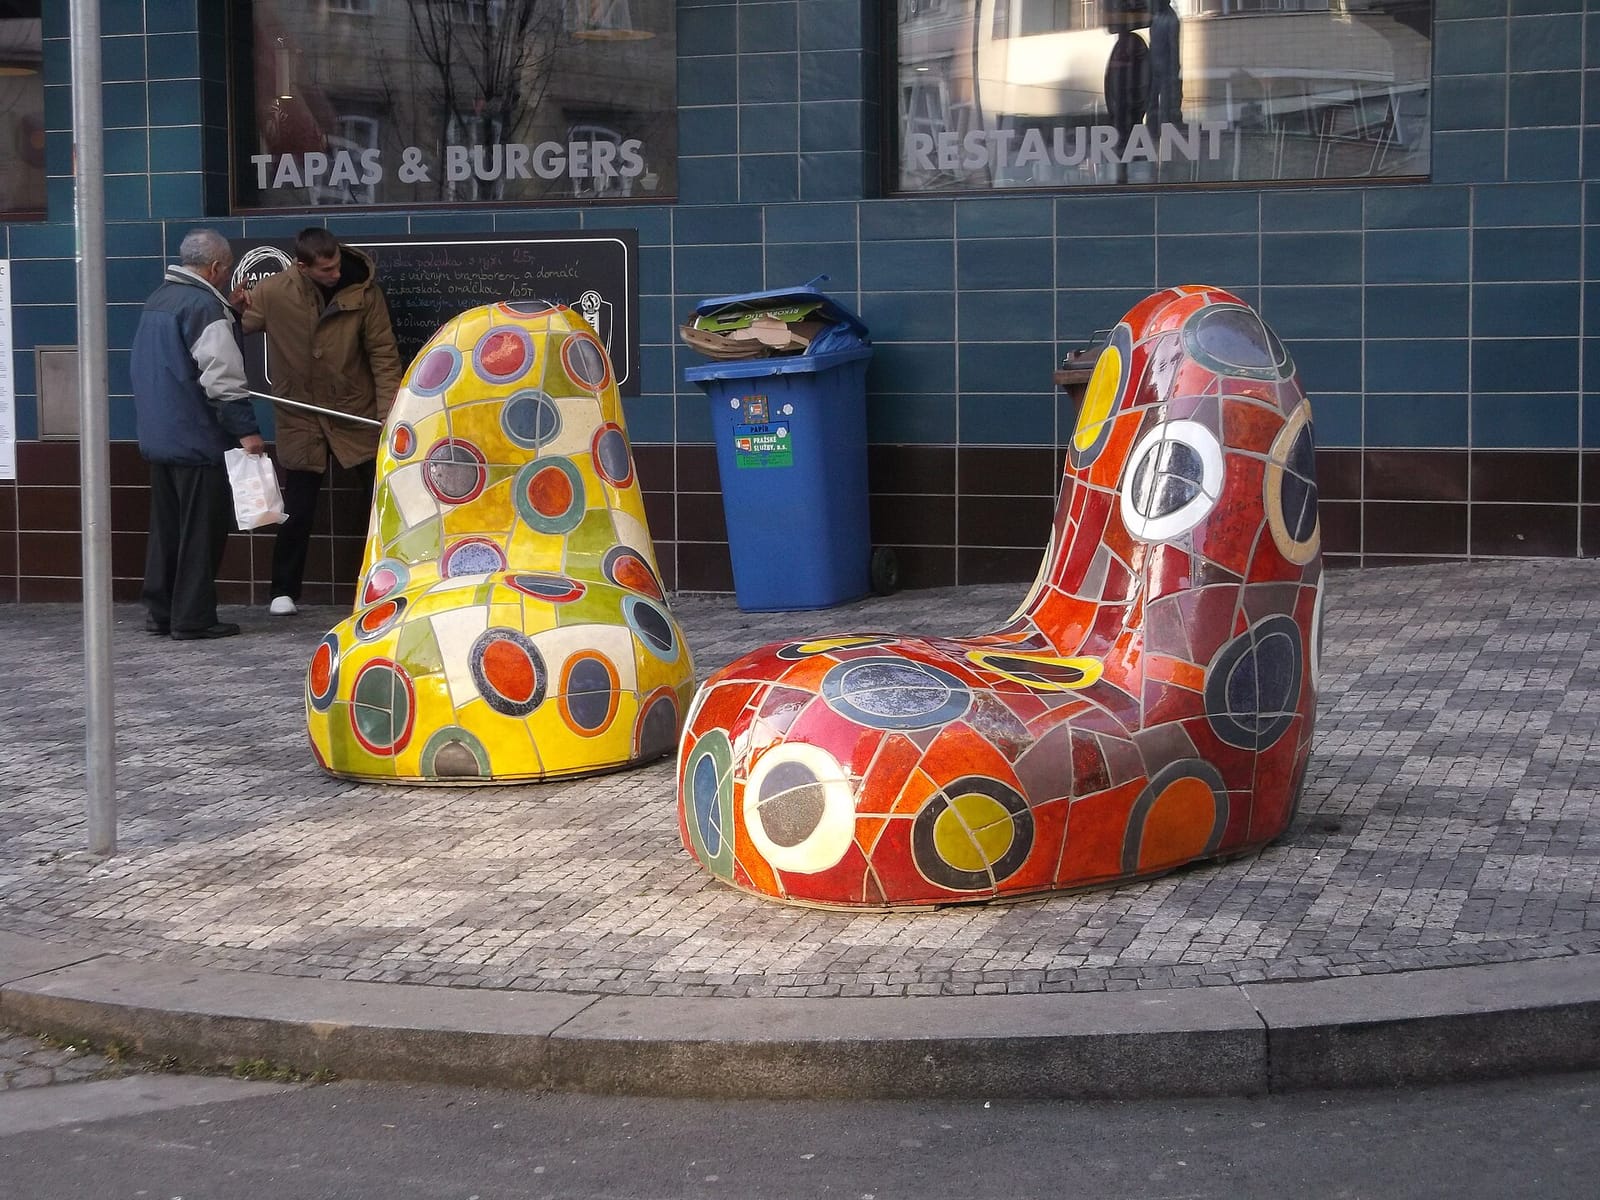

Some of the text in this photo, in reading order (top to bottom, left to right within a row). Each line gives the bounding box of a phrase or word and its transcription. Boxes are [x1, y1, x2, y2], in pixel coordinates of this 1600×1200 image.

[251, 139, 645, 190] TAPAS & BURGERS
[904, 121, 1229, 171] RESTAURANT
